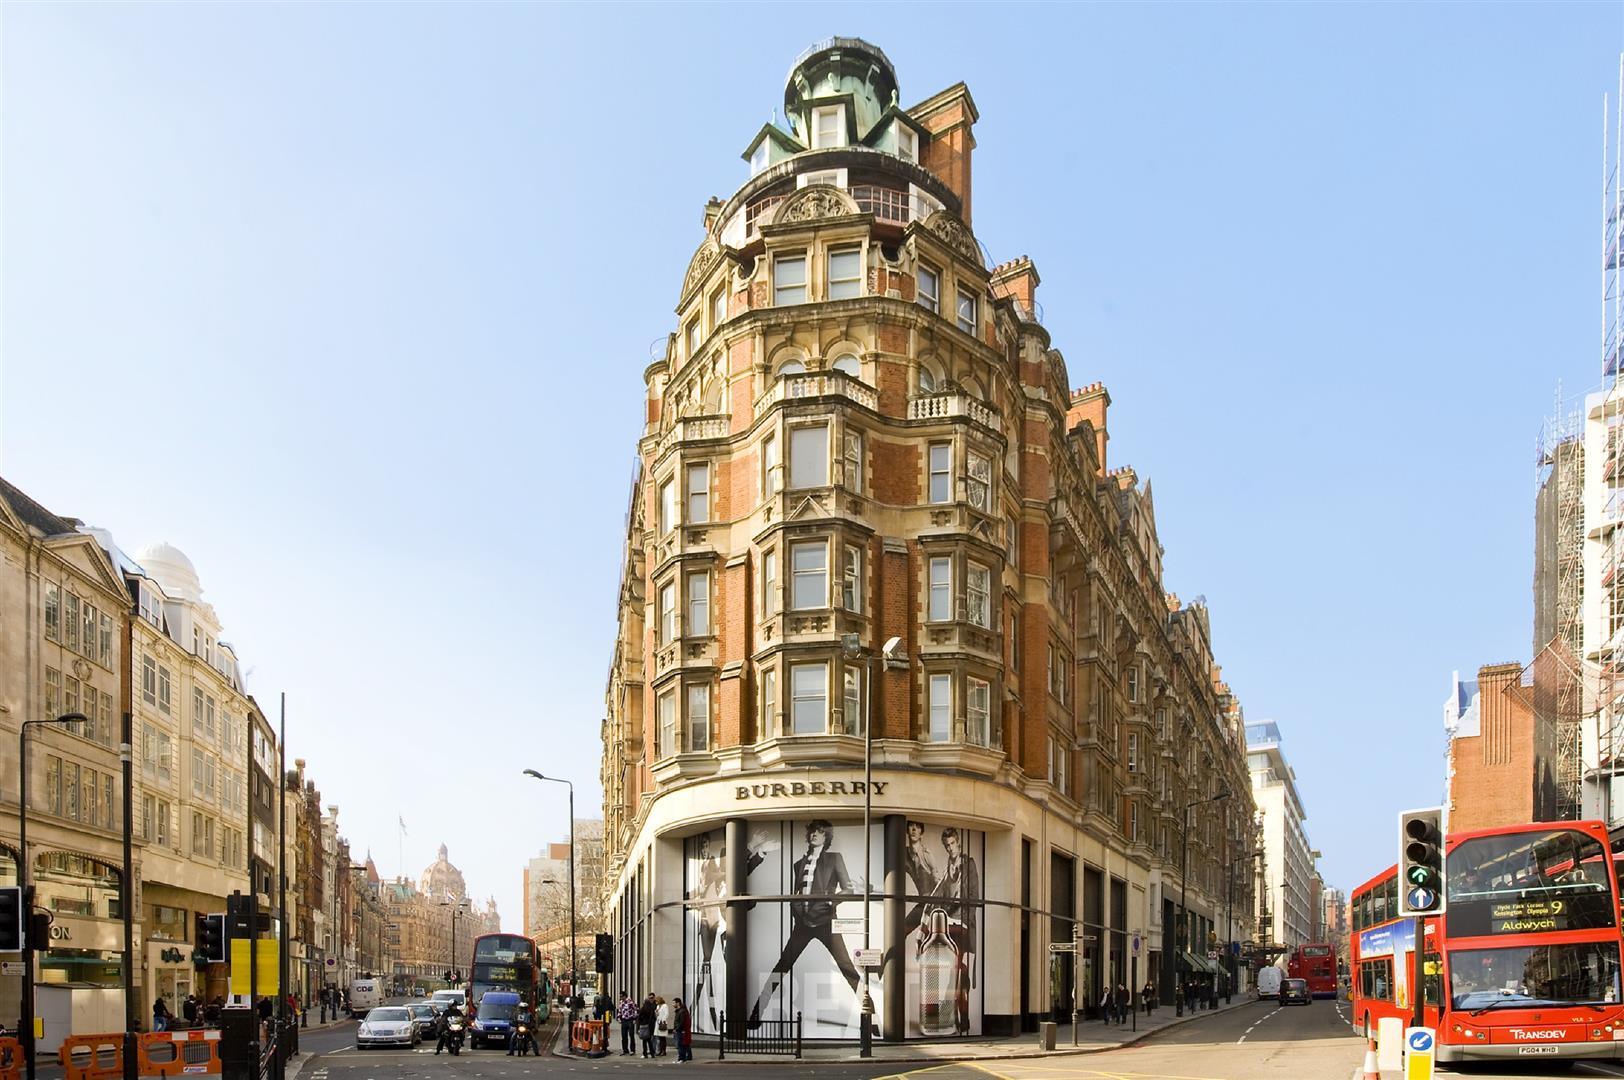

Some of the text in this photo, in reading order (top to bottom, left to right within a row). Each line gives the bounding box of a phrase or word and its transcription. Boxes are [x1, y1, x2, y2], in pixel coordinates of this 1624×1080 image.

[735, 781, 889, 800] BURBERRY
[1551, 901, 1563, 914] 9
[1502, 919, 1555, 930] Aldwych
[1509, 1029, 1566, 1039] TRANSDEV
